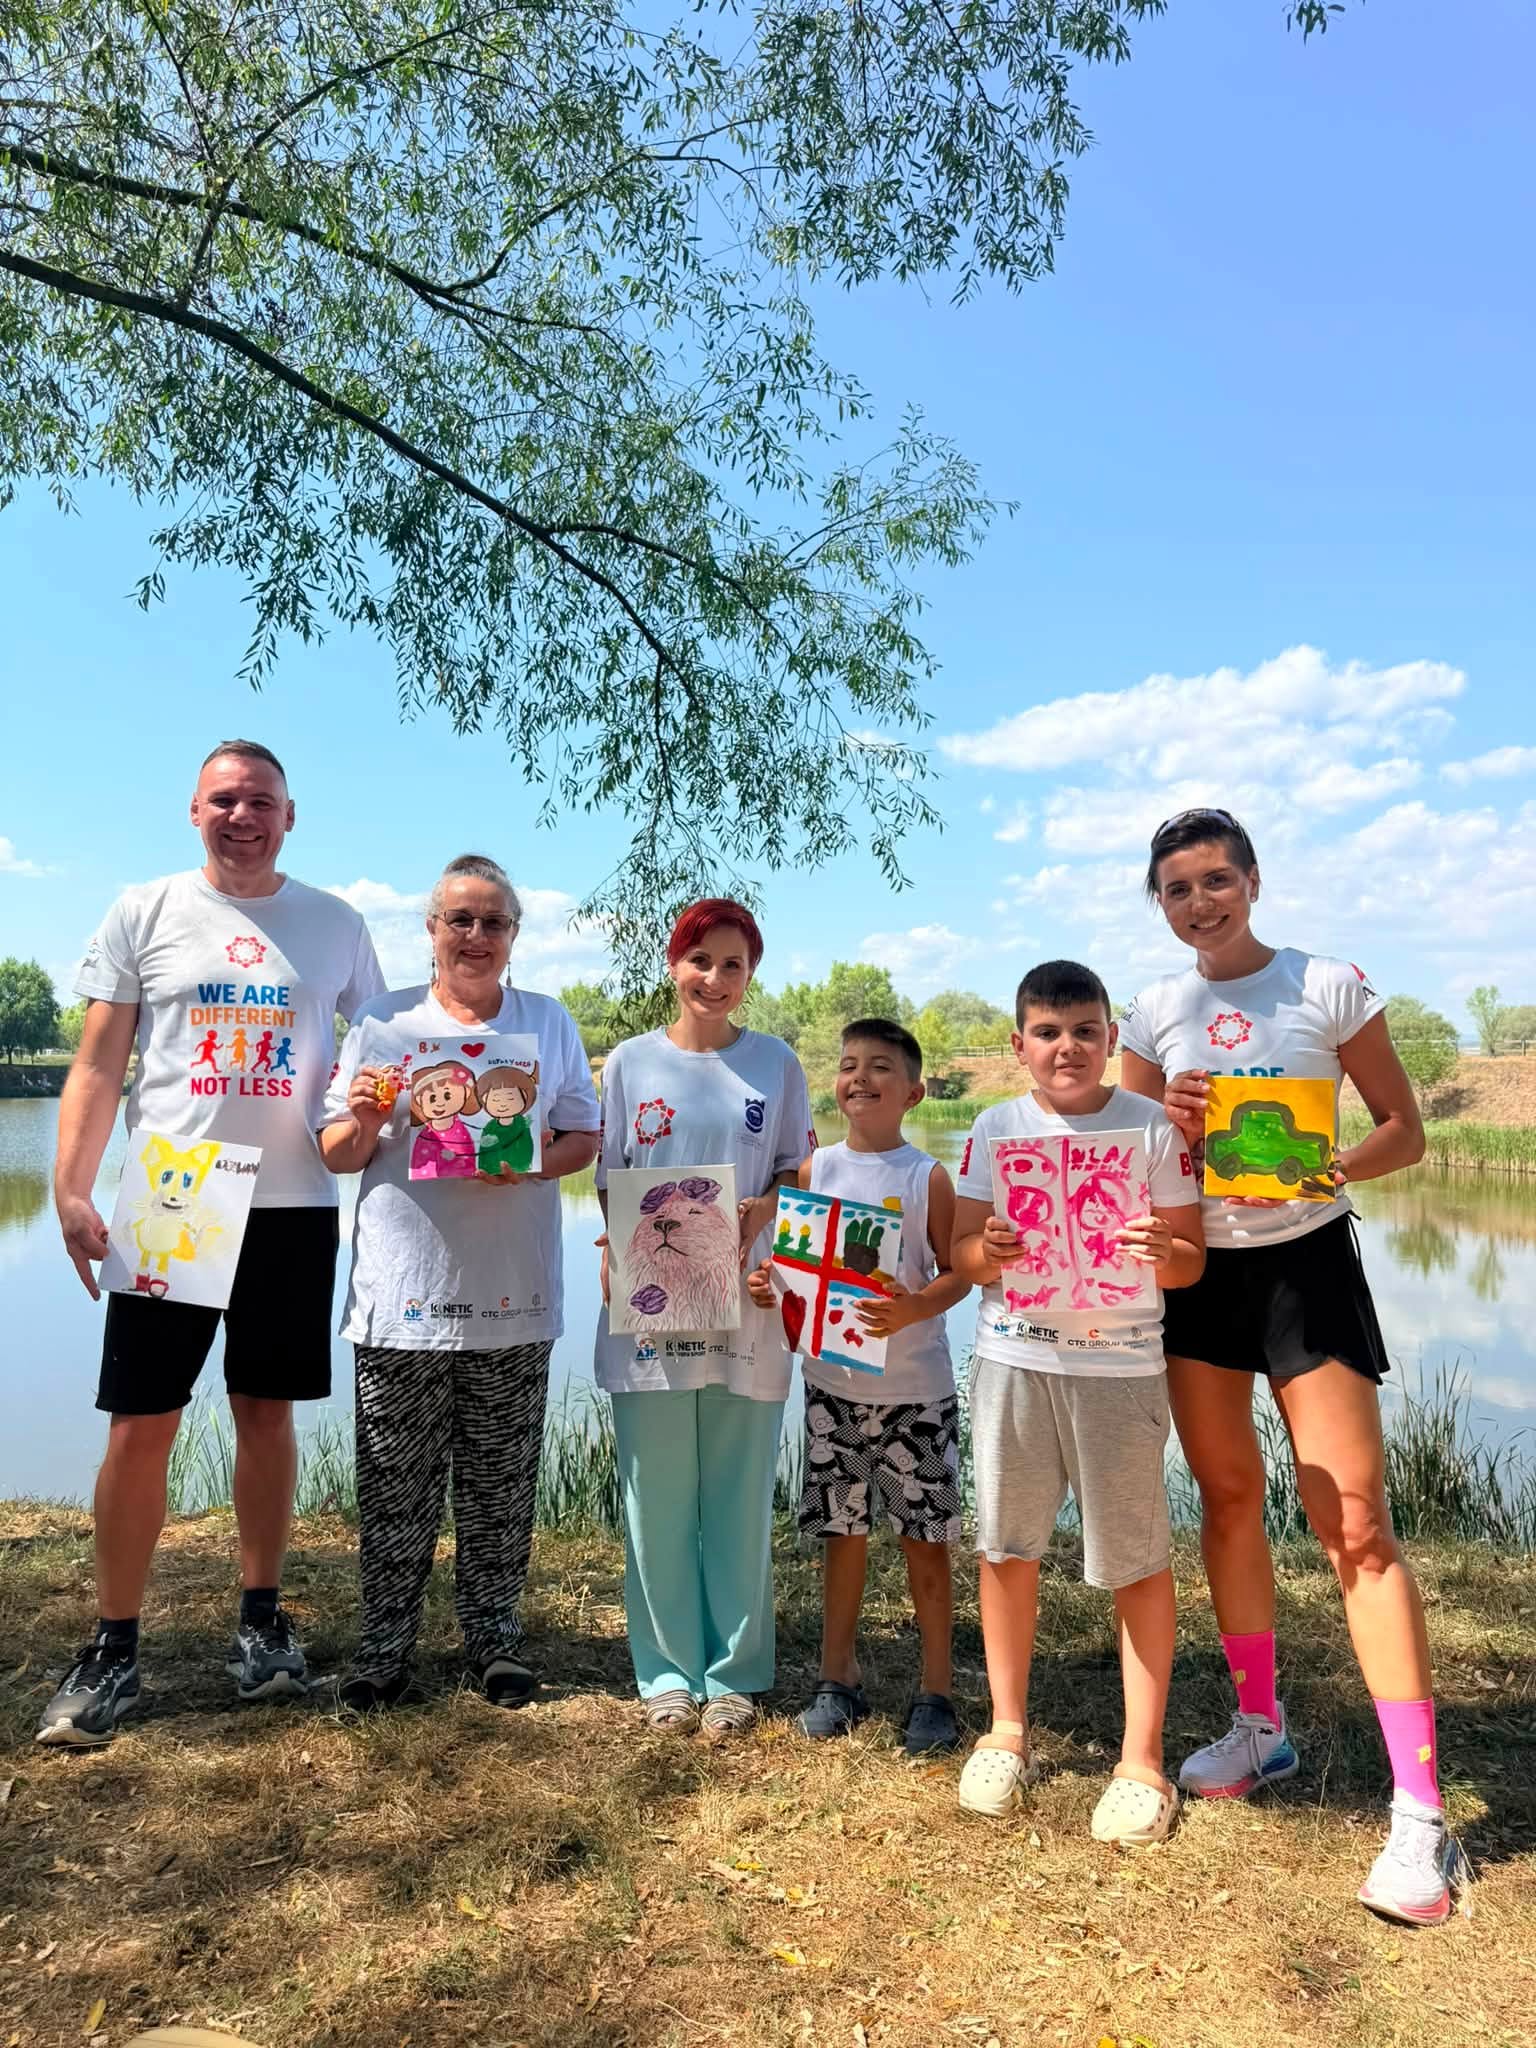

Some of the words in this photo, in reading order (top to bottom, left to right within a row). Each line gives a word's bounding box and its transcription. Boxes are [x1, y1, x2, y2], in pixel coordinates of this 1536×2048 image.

[197, 983, 237, 1004] WE
[242, 985, 290, 1006] ARE
[190, 1007, 297, 1028] DIFFERENT
[191, 1077, 231, 1096] NOT
[239, 1077, 292, 1097] LESS
[1067, 1339, 1086, 1347] CTC
[1088, 1339, 1120, 1347] GROUP
